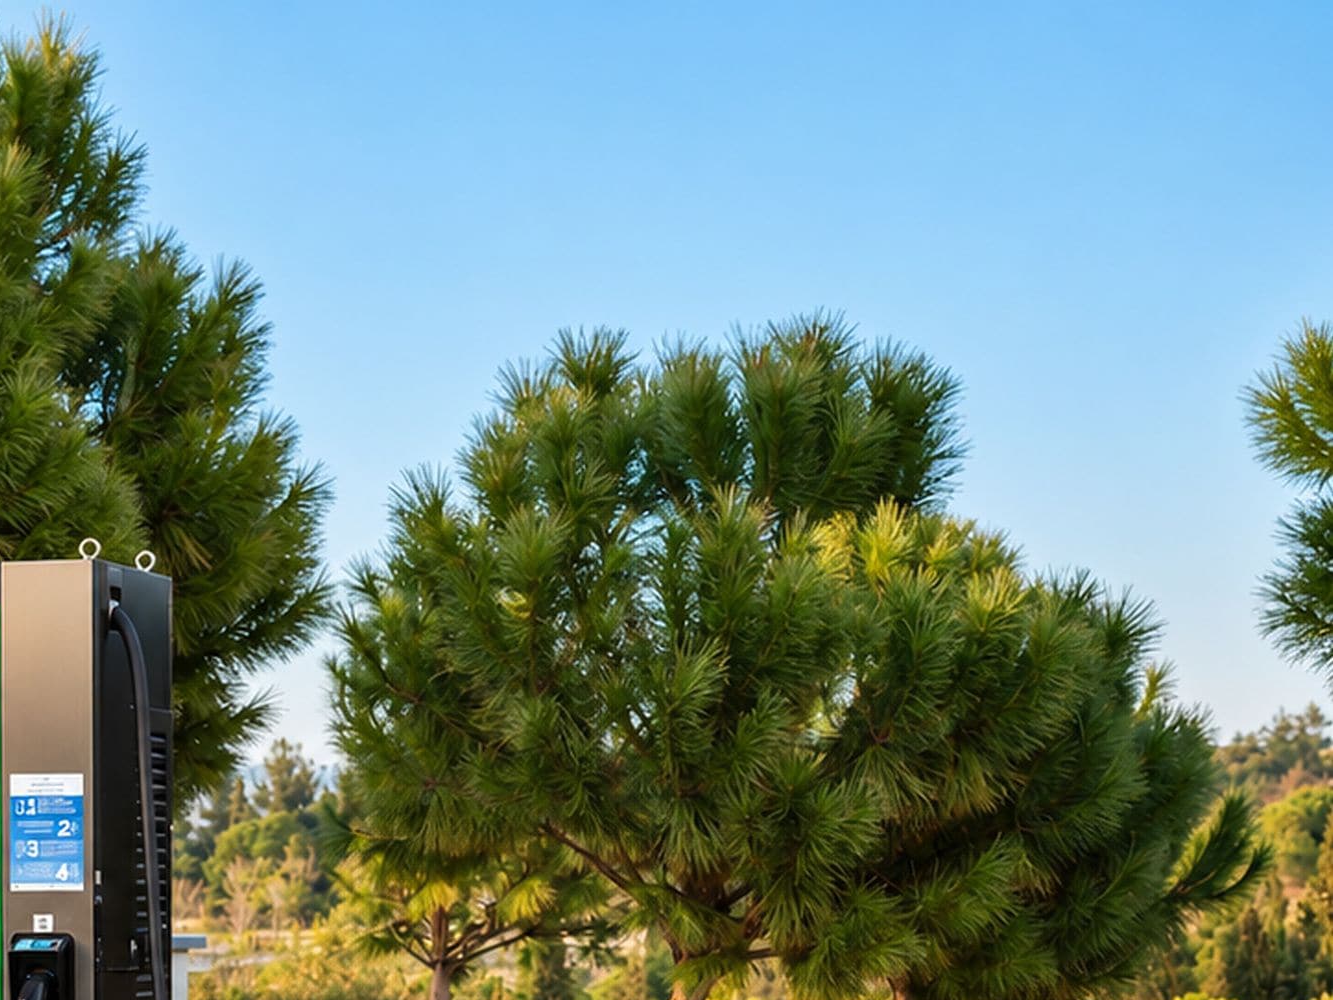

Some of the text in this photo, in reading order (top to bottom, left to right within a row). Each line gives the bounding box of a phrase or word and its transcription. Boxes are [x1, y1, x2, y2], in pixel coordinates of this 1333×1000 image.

[57, 819, 72, 837] 2
[26, 839, 39, 858] 3
[55, 863, 69, 881] 4
